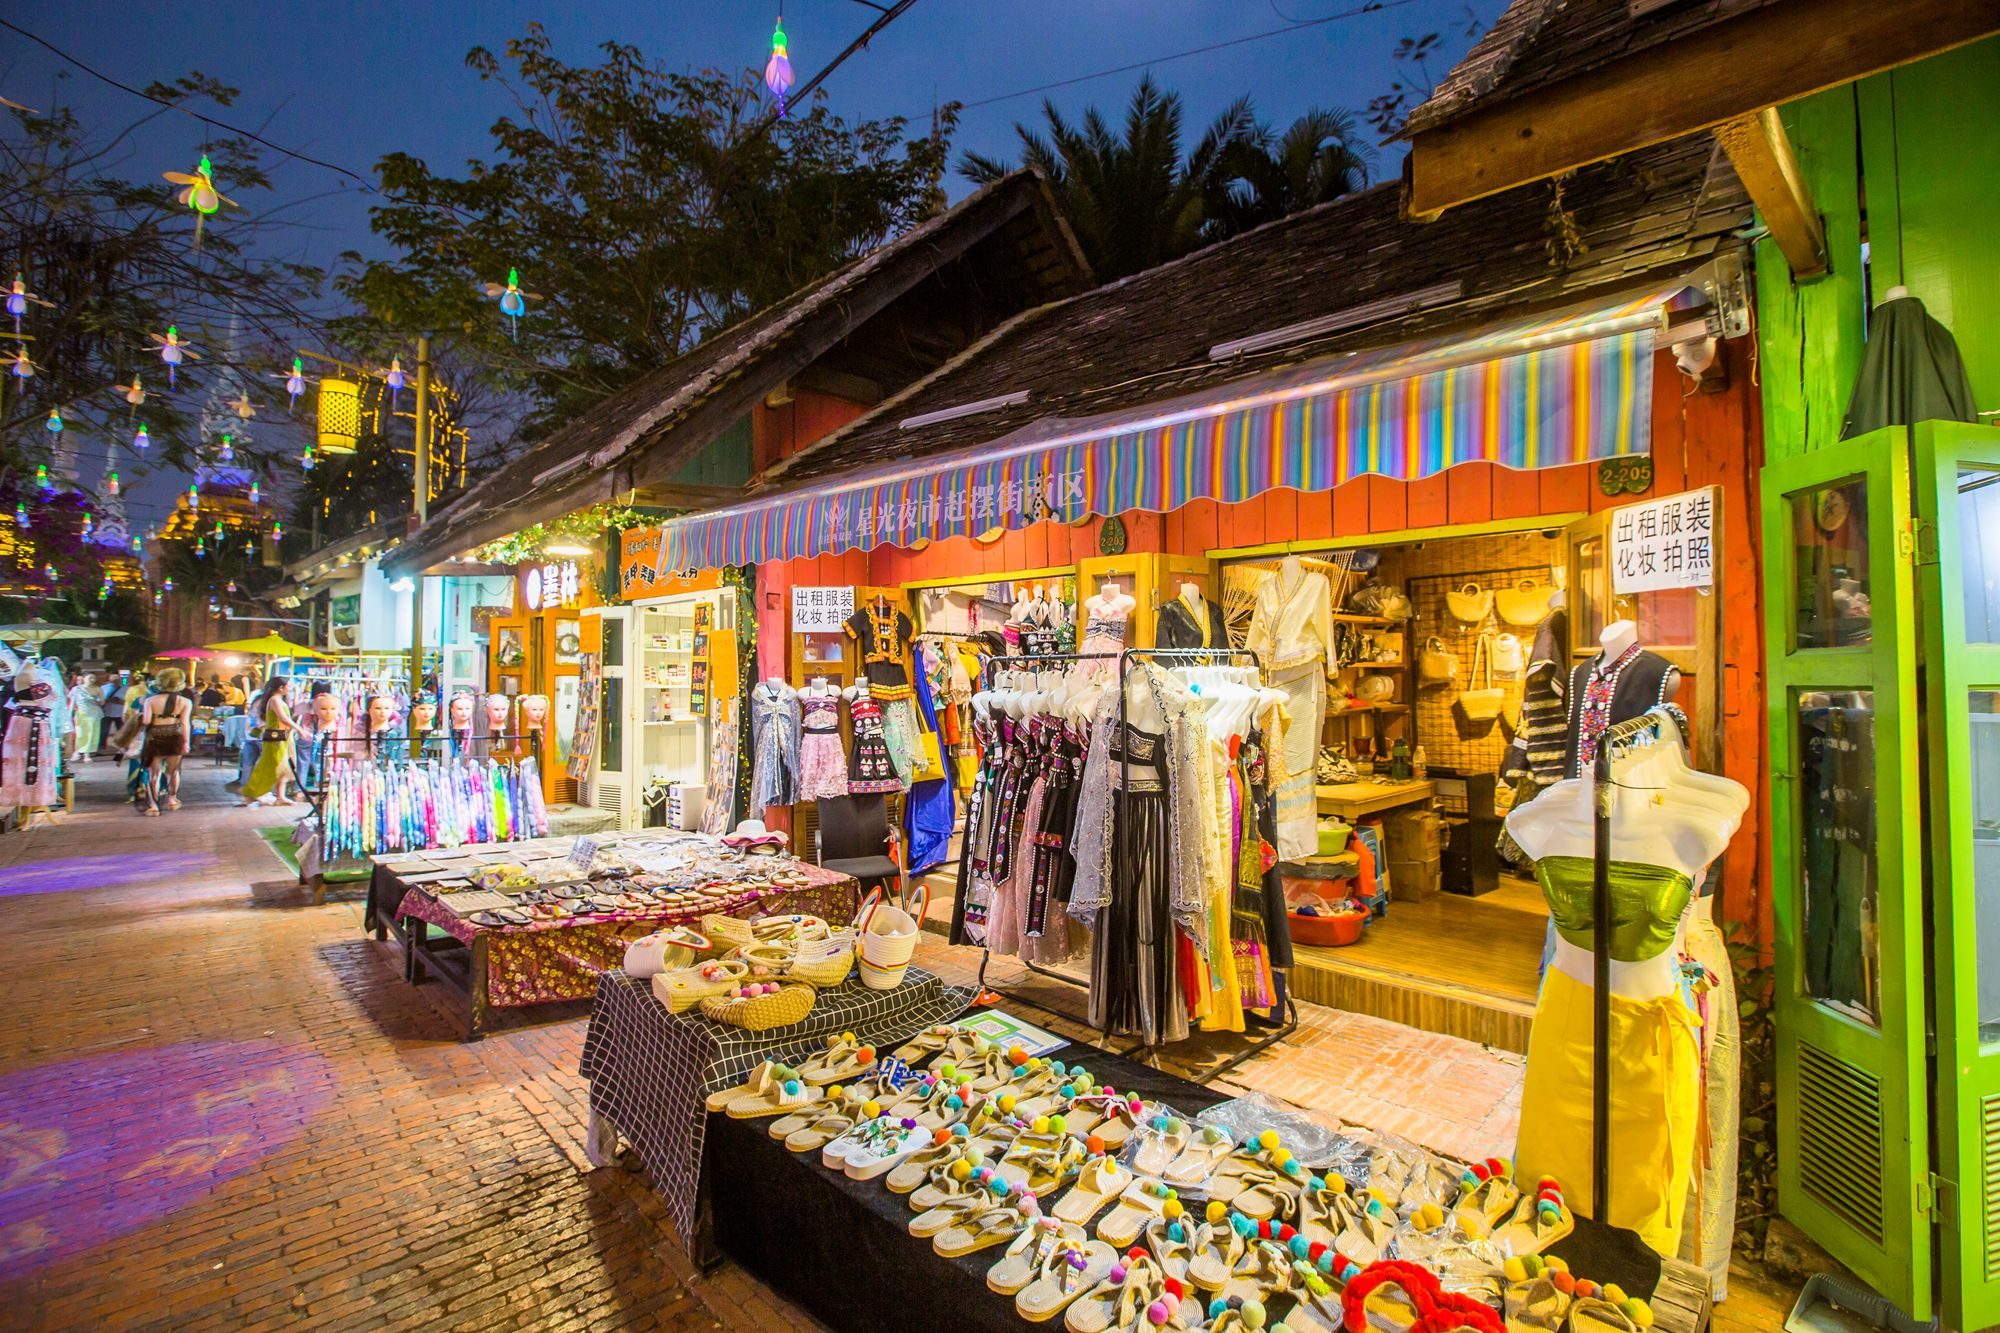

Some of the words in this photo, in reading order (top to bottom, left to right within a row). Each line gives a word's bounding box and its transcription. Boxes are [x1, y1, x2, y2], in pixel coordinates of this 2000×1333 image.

[1602, 465, 1651, 483] 2-205
[1617, 496, 1711, 544] 出租服装
[1101, 536, 1125, 547] 2-203
[1617, 535, 1711, 579] 化妆拍照
[796, 590, 853, 607] 出租服装
